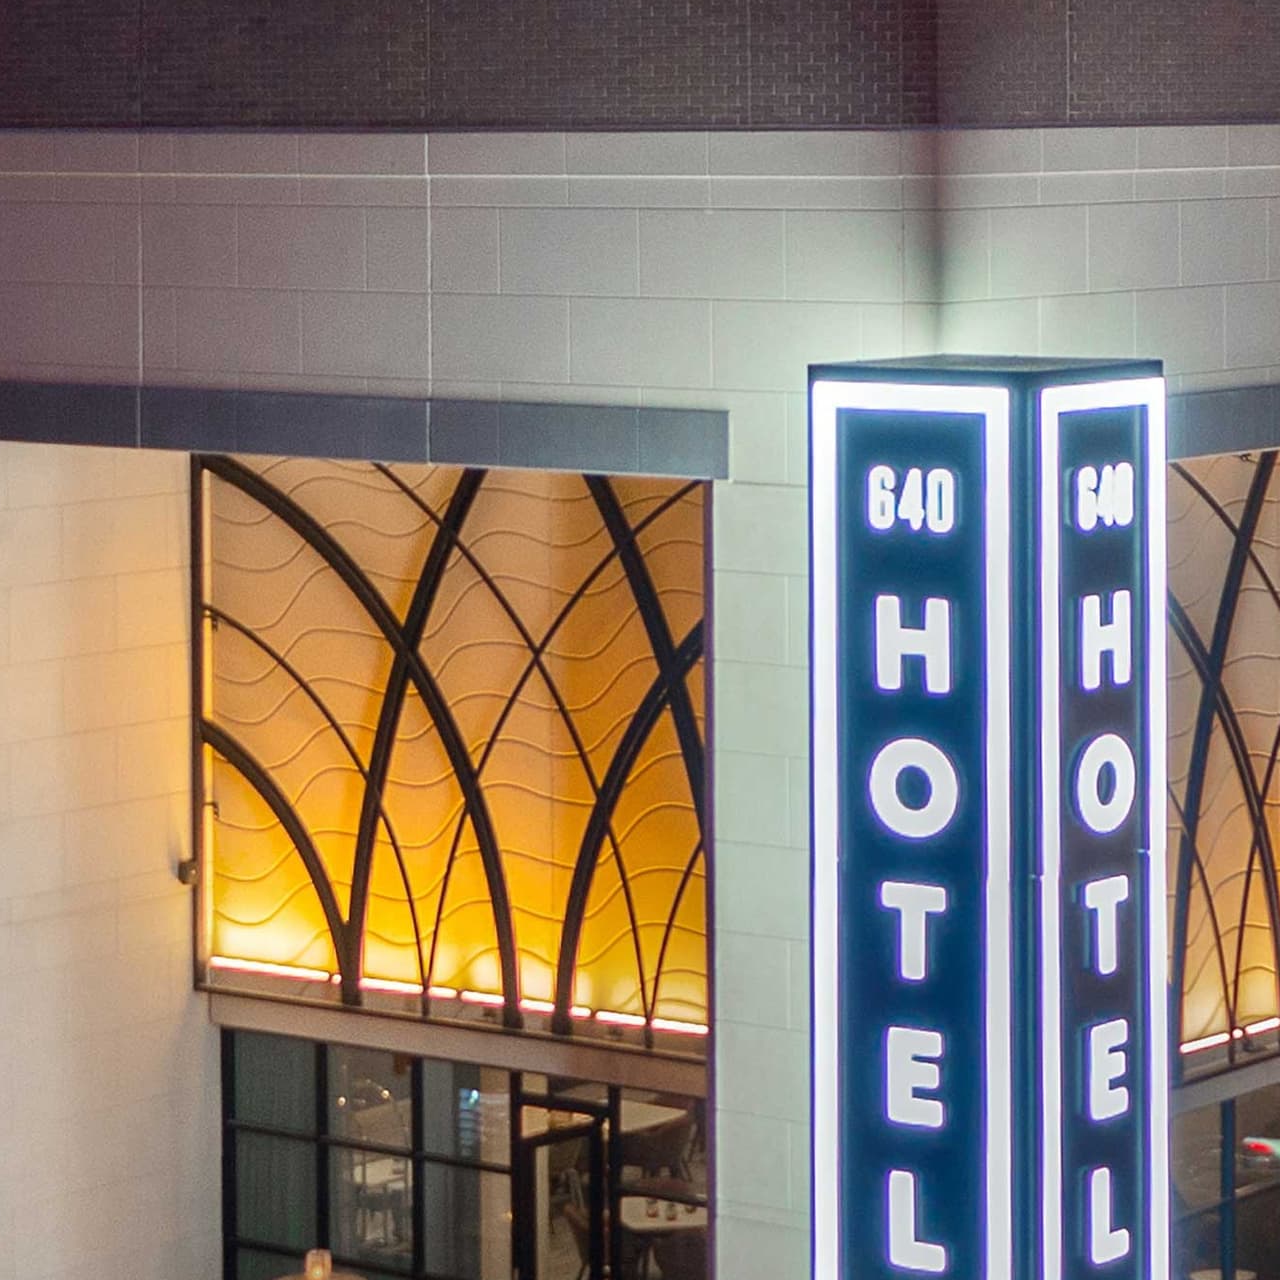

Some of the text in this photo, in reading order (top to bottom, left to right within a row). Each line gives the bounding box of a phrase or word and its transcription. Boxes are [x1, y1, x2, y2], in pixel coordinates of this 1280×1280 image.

[867, 464, 956, 534] 640
[1076, 461, 1135, 532] 640
[868, 593, 960, 1273] HOTEL
[1076, 588, 1137, 1266] HOTEL
